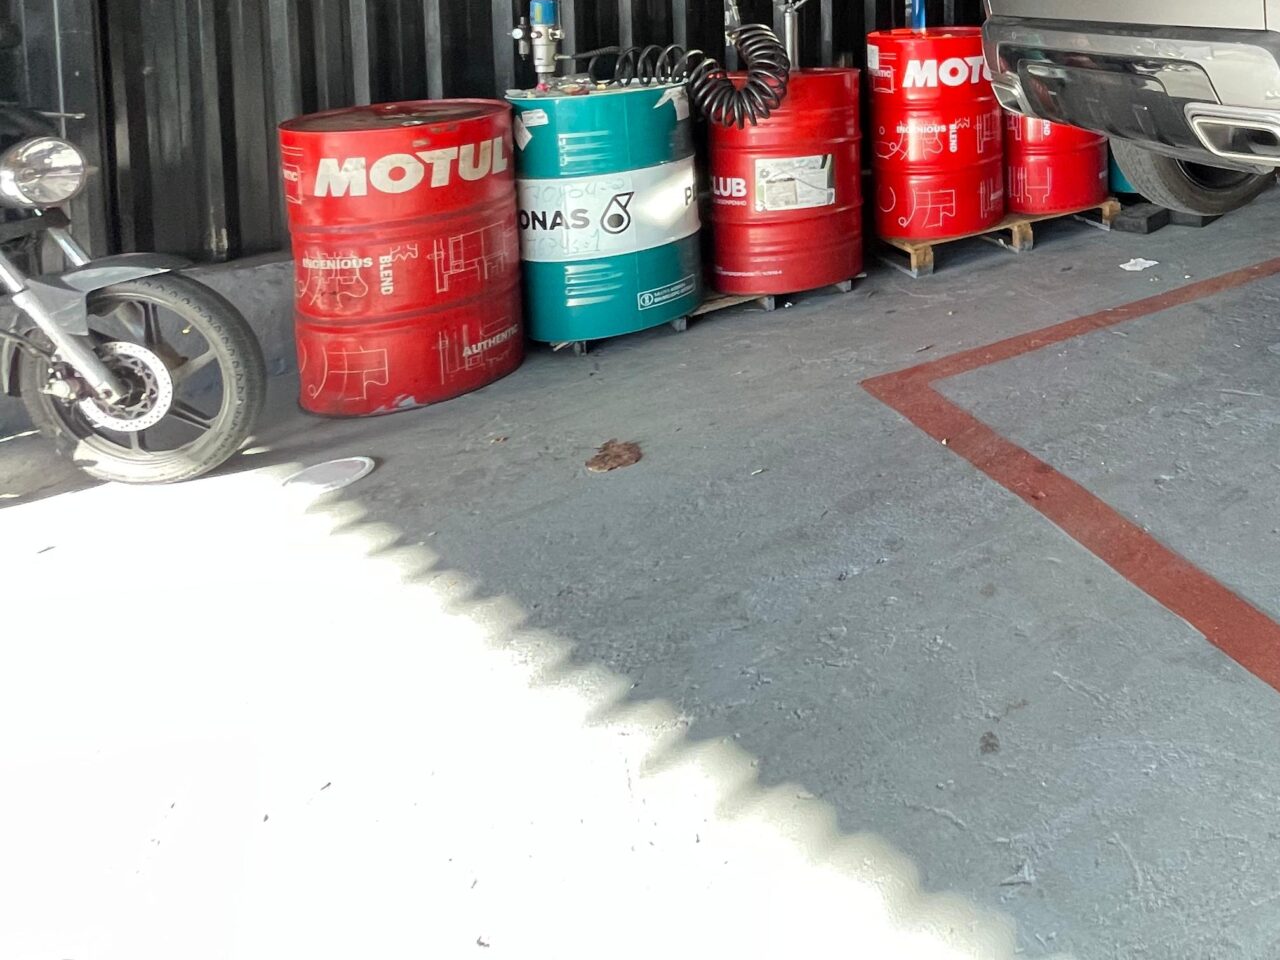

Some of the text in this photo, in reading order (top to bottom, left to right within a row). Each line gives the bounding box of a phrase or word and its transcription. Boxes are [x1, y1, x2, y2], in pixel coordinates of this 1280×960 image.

[901, 55, 993, 88] MOT
[1043, 120, 1051, 136] END
[313, 136, 508, 198] MOTUL
[712, 176, 747, 198] LUB
[302, 256, 373, 270] INGENIOUS
[379, 254, 394, 296] BLEND
